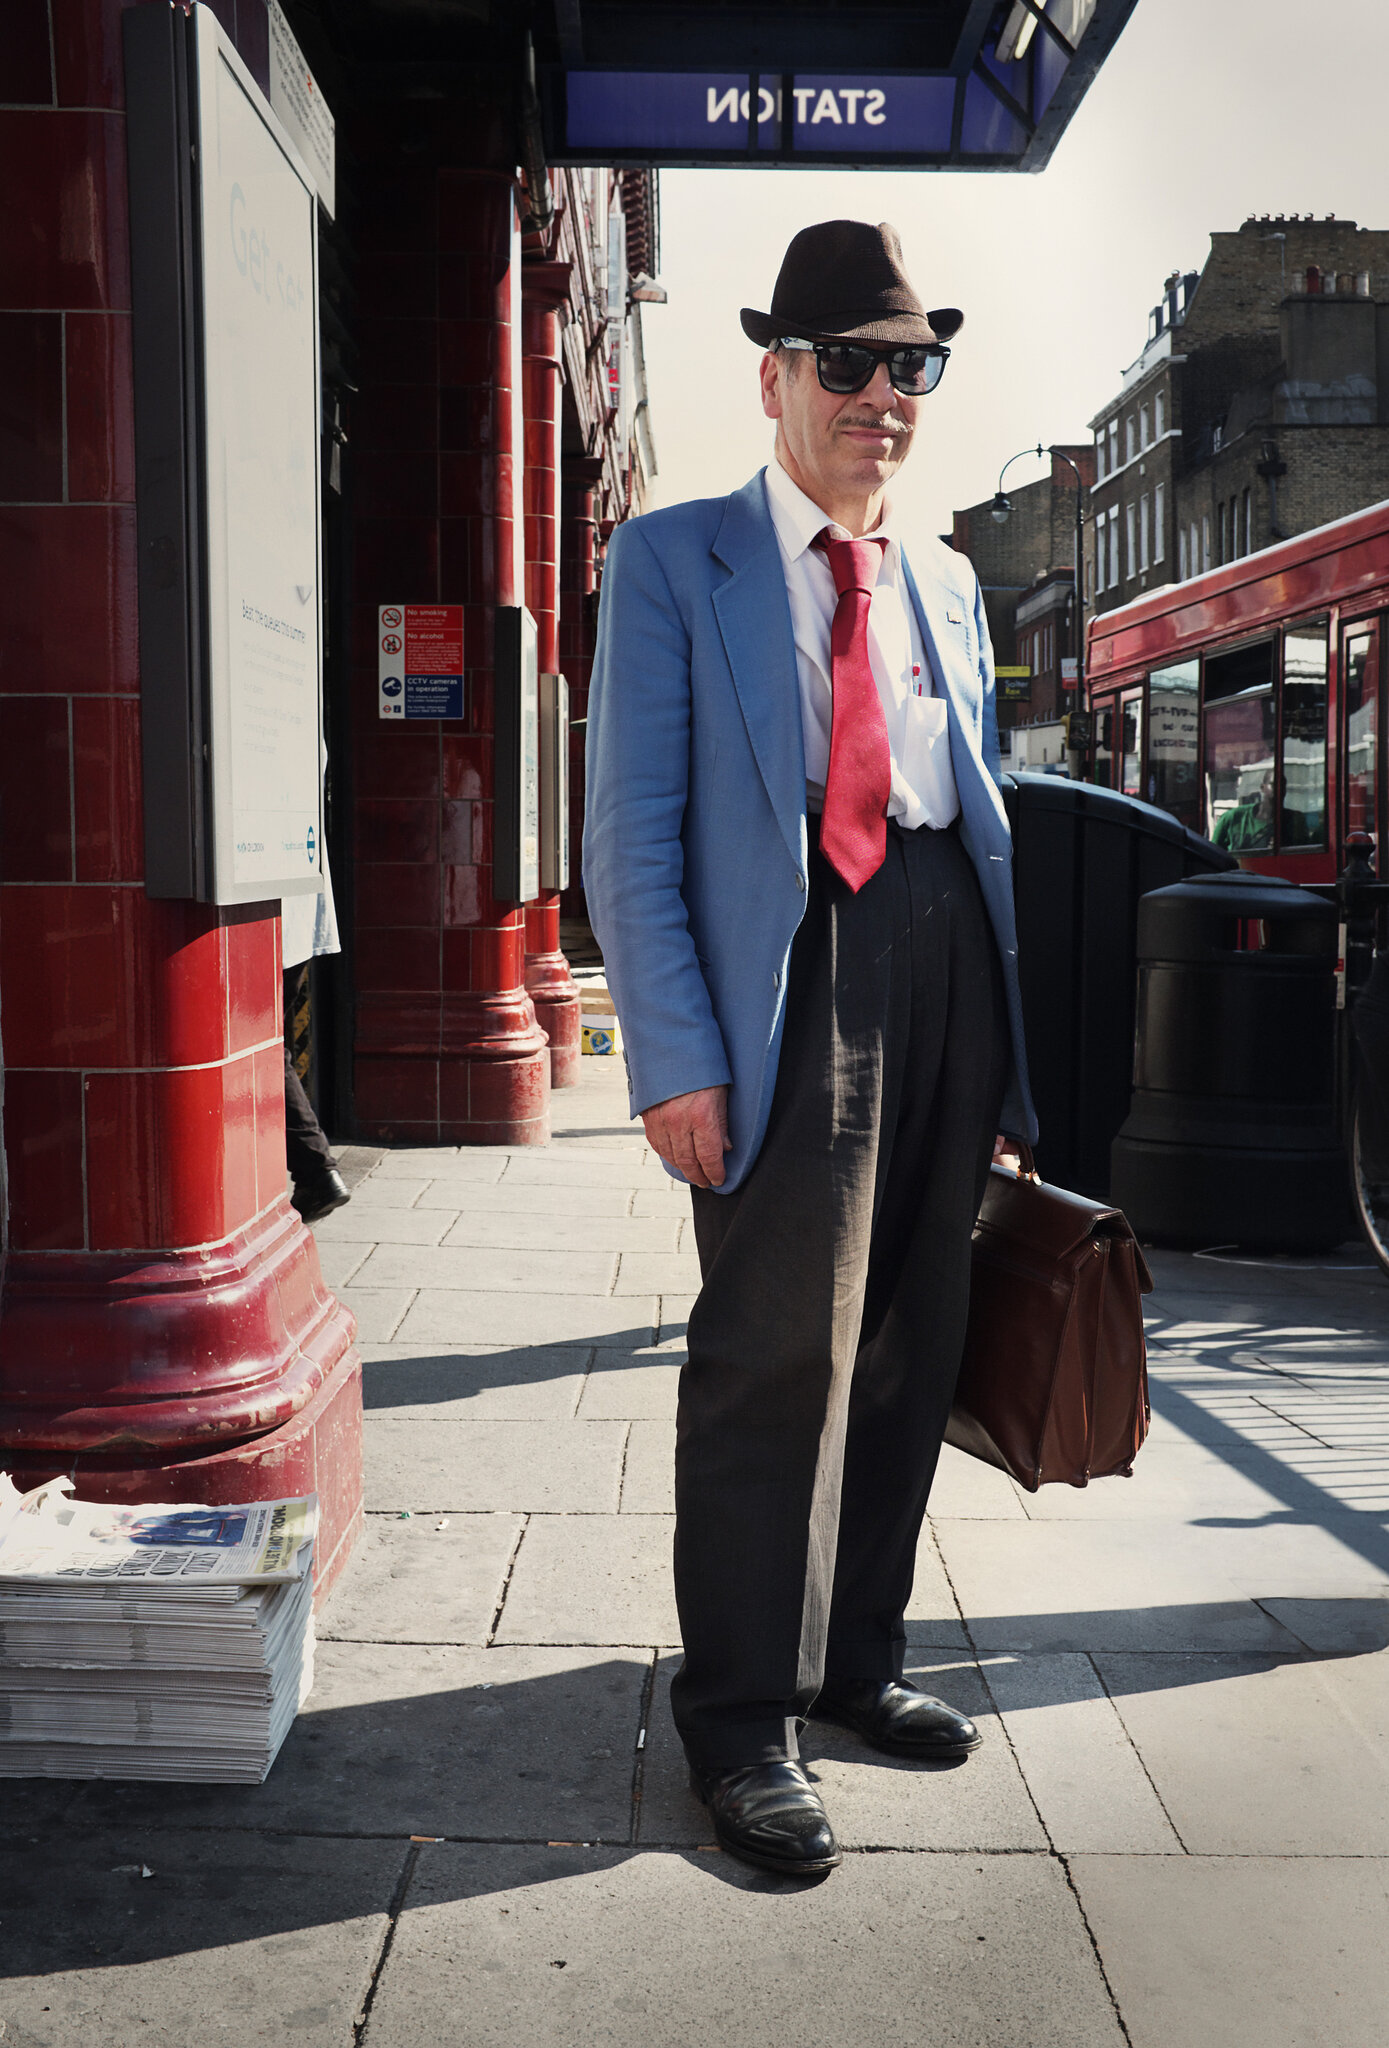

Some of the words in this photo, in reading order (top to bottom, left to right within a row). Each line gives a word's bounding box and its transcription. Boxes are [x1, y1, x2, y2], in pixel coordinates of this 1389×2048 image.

[230, 182, 270, 304] Get
[420, 609, 447, 617] smoking
[407, 677, 428, 685] CCTV
[415, 686, 449, 694] operation
